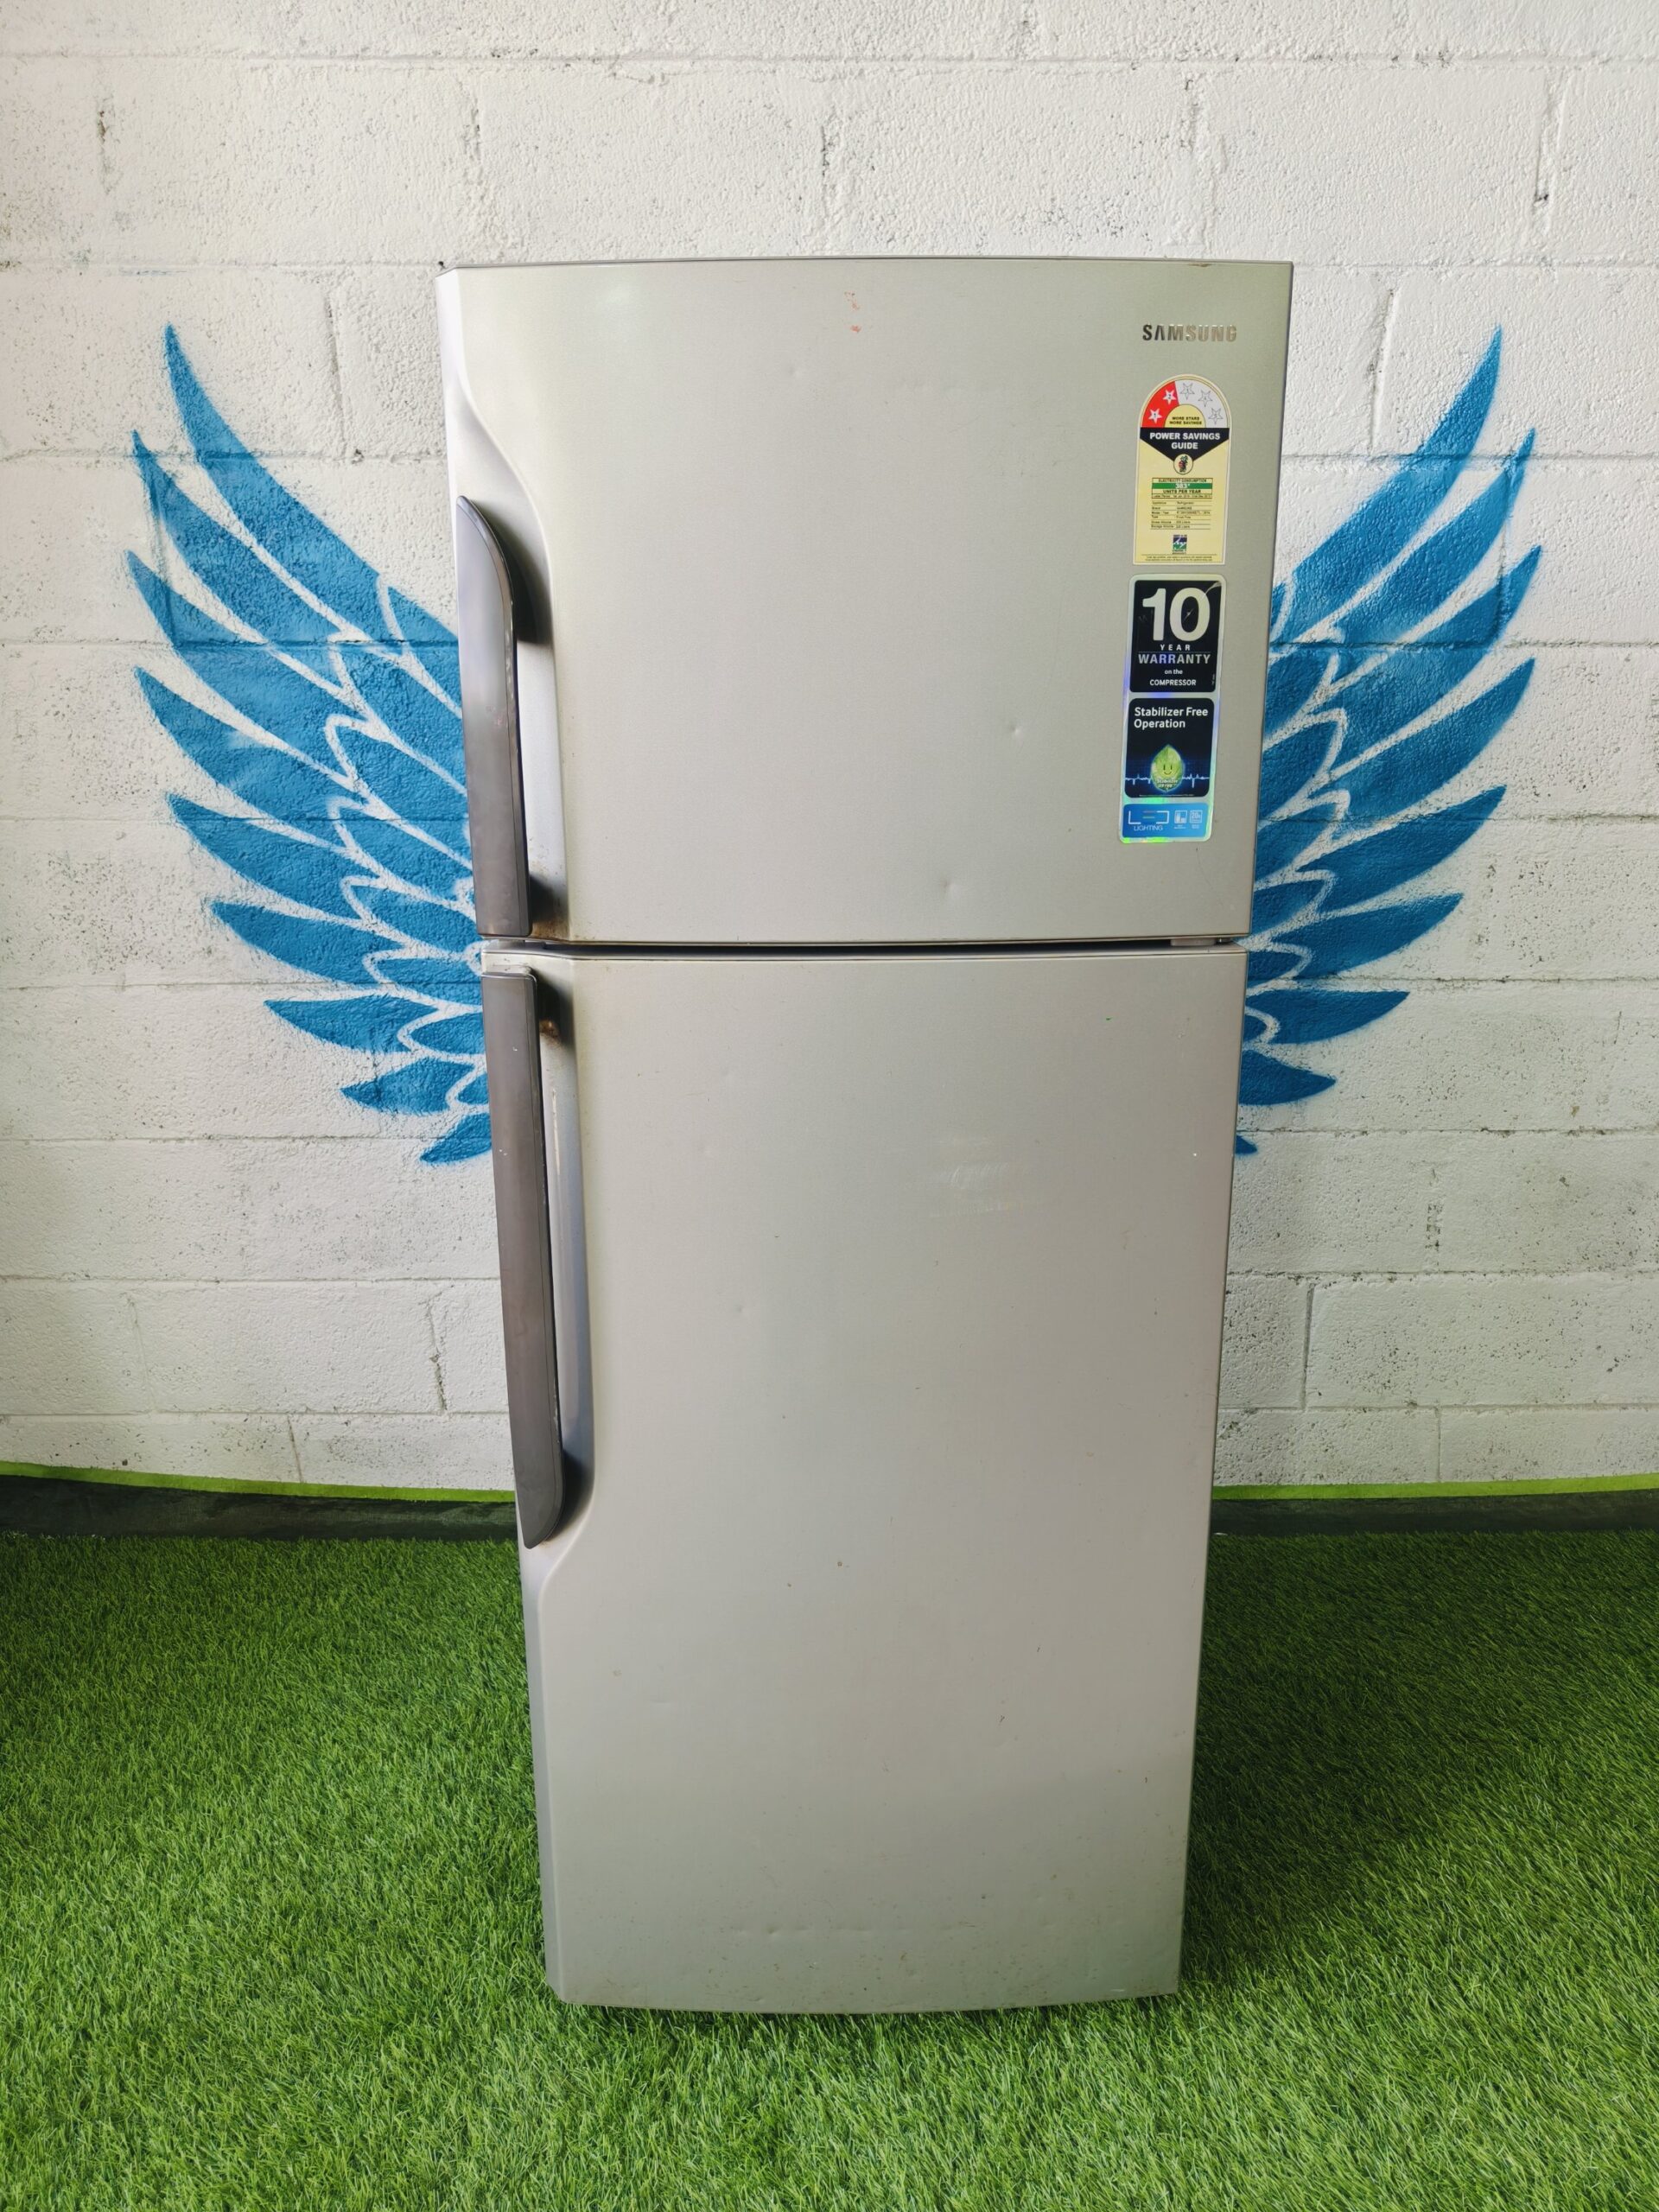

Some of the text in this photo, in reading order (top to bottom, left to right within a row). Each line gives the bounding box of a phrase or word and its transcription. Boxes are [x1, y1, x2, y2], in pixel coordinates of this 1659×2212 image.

[1142, 324, 1236, 342] SAMSUNG
[1142, 587, 1211, 642] 10
[1138, 653, 1211, 664] WARRANTY
[1134, 707, 1209, 716] Stabilizer Free
[1134, 718, 1186, 730] Operation
